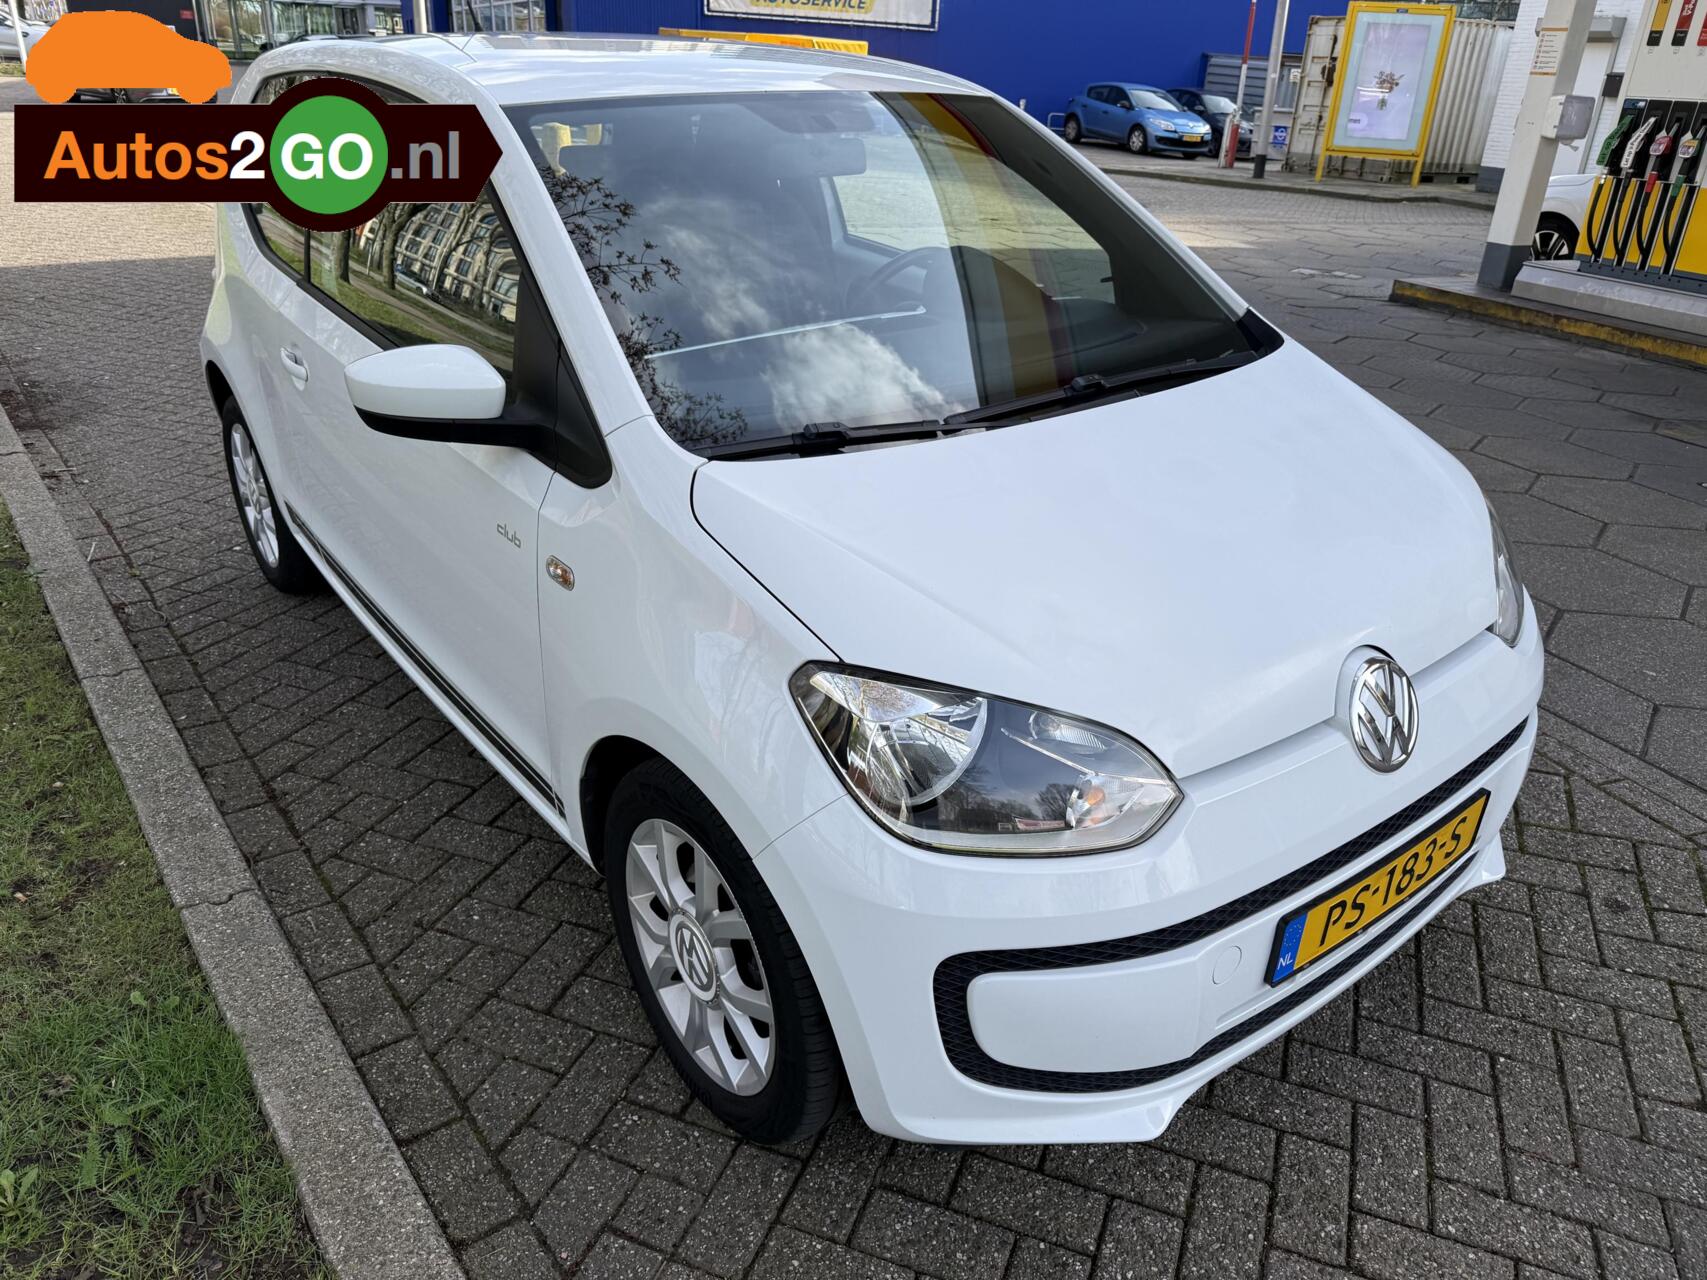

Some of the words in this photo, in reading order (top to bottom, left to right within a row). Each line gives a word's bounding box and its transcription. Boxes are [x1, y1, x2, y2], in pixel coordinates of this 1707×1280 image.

[756, 0, 866, 9] ERVICE
[497, 523, 522, 549] club
[1318, 815, 1468, 948] PS-183-S
[1277, 952, 1294, 970] NL
